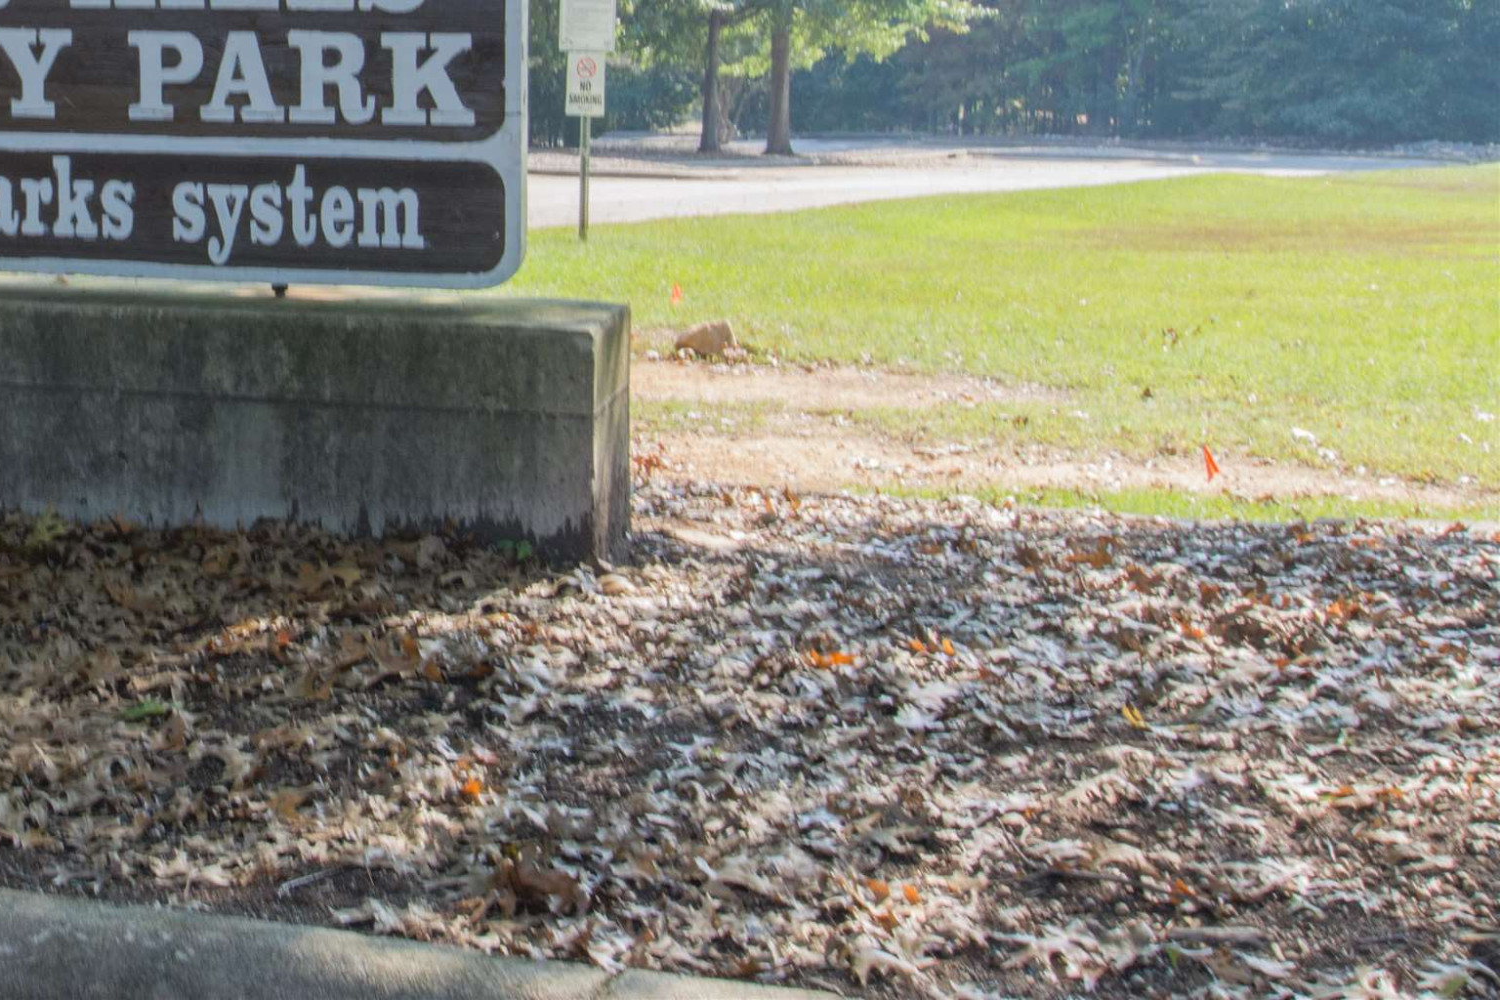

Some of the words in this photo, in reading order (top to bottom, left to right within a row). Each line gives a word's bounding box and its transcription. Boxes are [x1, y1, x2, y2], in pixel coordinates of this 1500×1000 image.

[127, 30, 476, 126] PARK
[569, 93, 603, 105] SMOKING
[580, 81, 592, 92] NO
[172, 165, 424, 264] system
